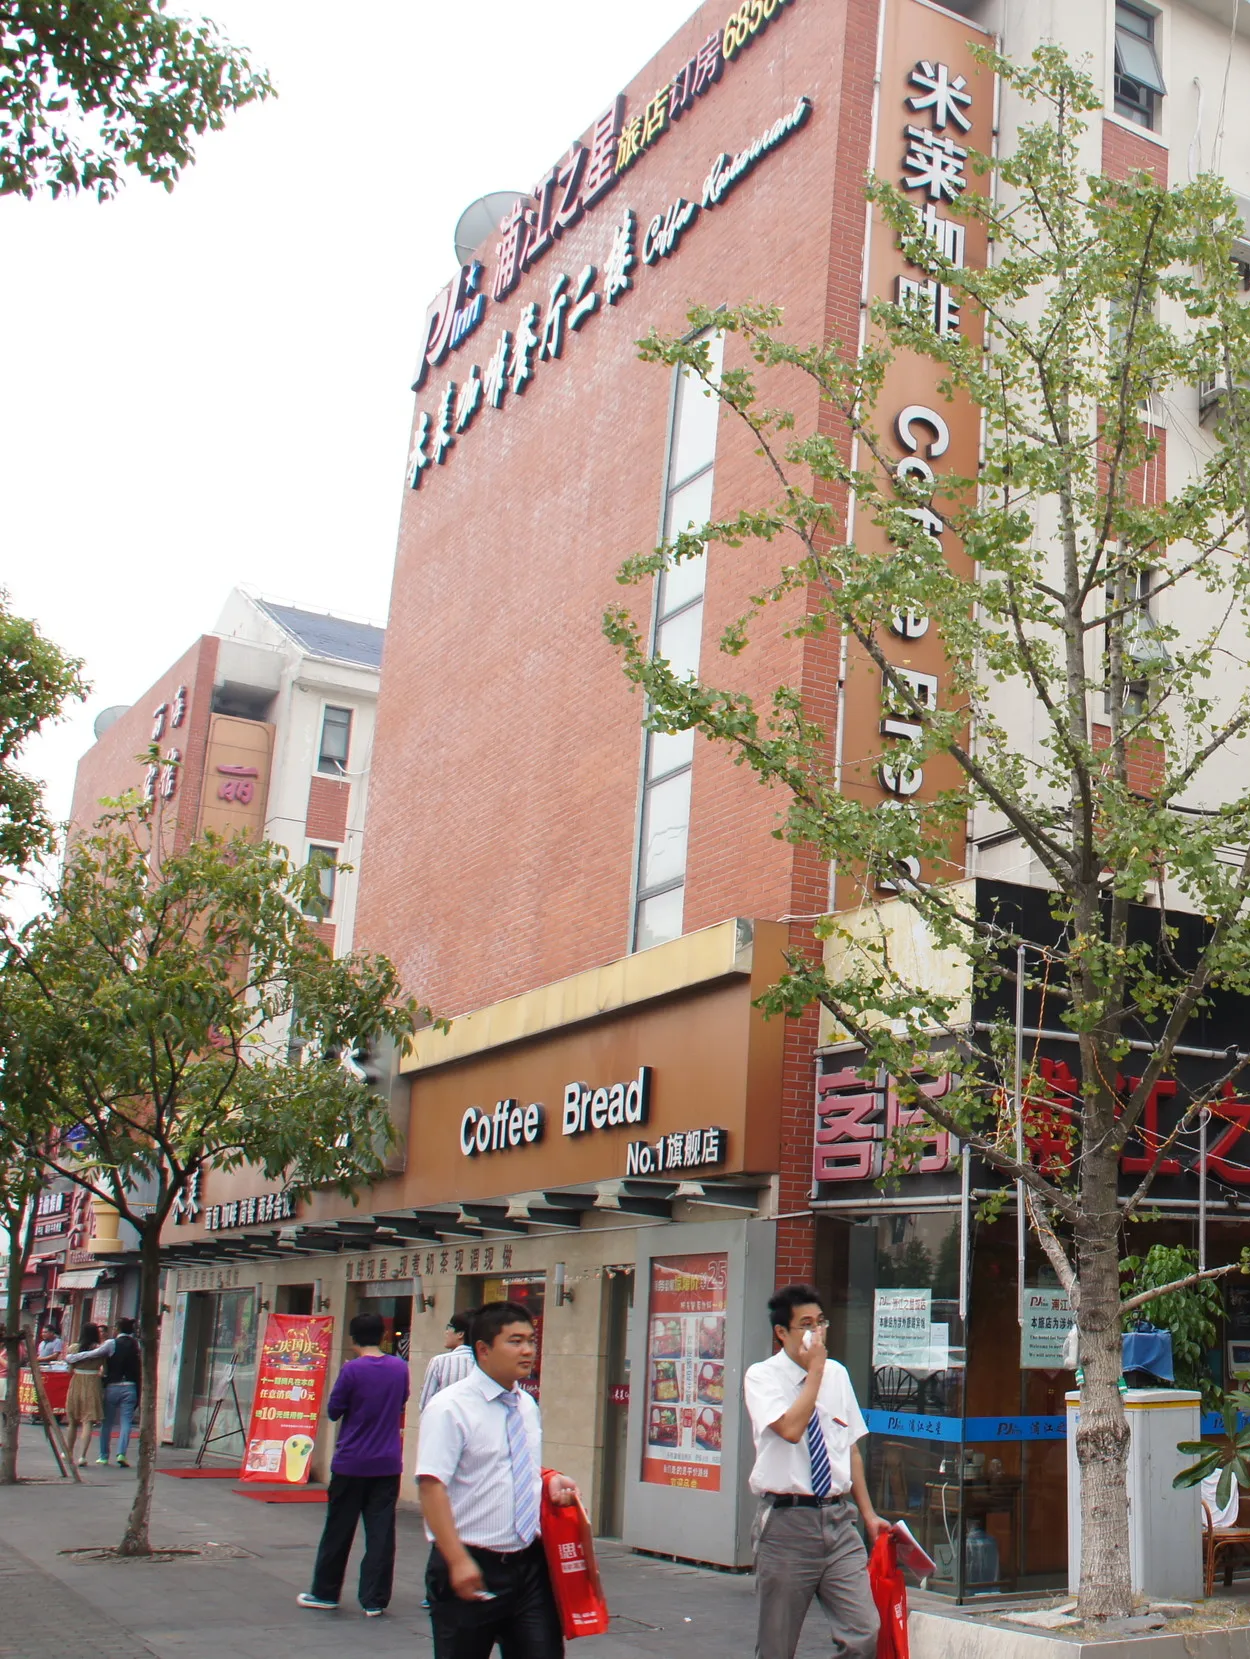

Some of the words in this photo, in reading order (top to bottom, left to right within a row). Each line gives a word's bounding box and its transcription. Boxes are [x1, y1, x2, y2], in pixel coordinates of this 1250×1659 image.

[493, 93, 622, 300] 浦江之星
[722, 0, 785, 60] 685
[899, 60, 972, 343] 米莱咖啡
[890, 404, 950, 639] Cofe
[460, 1100, 539, 1156] Coffee
[562, 1066, 646, 1136] Bread
